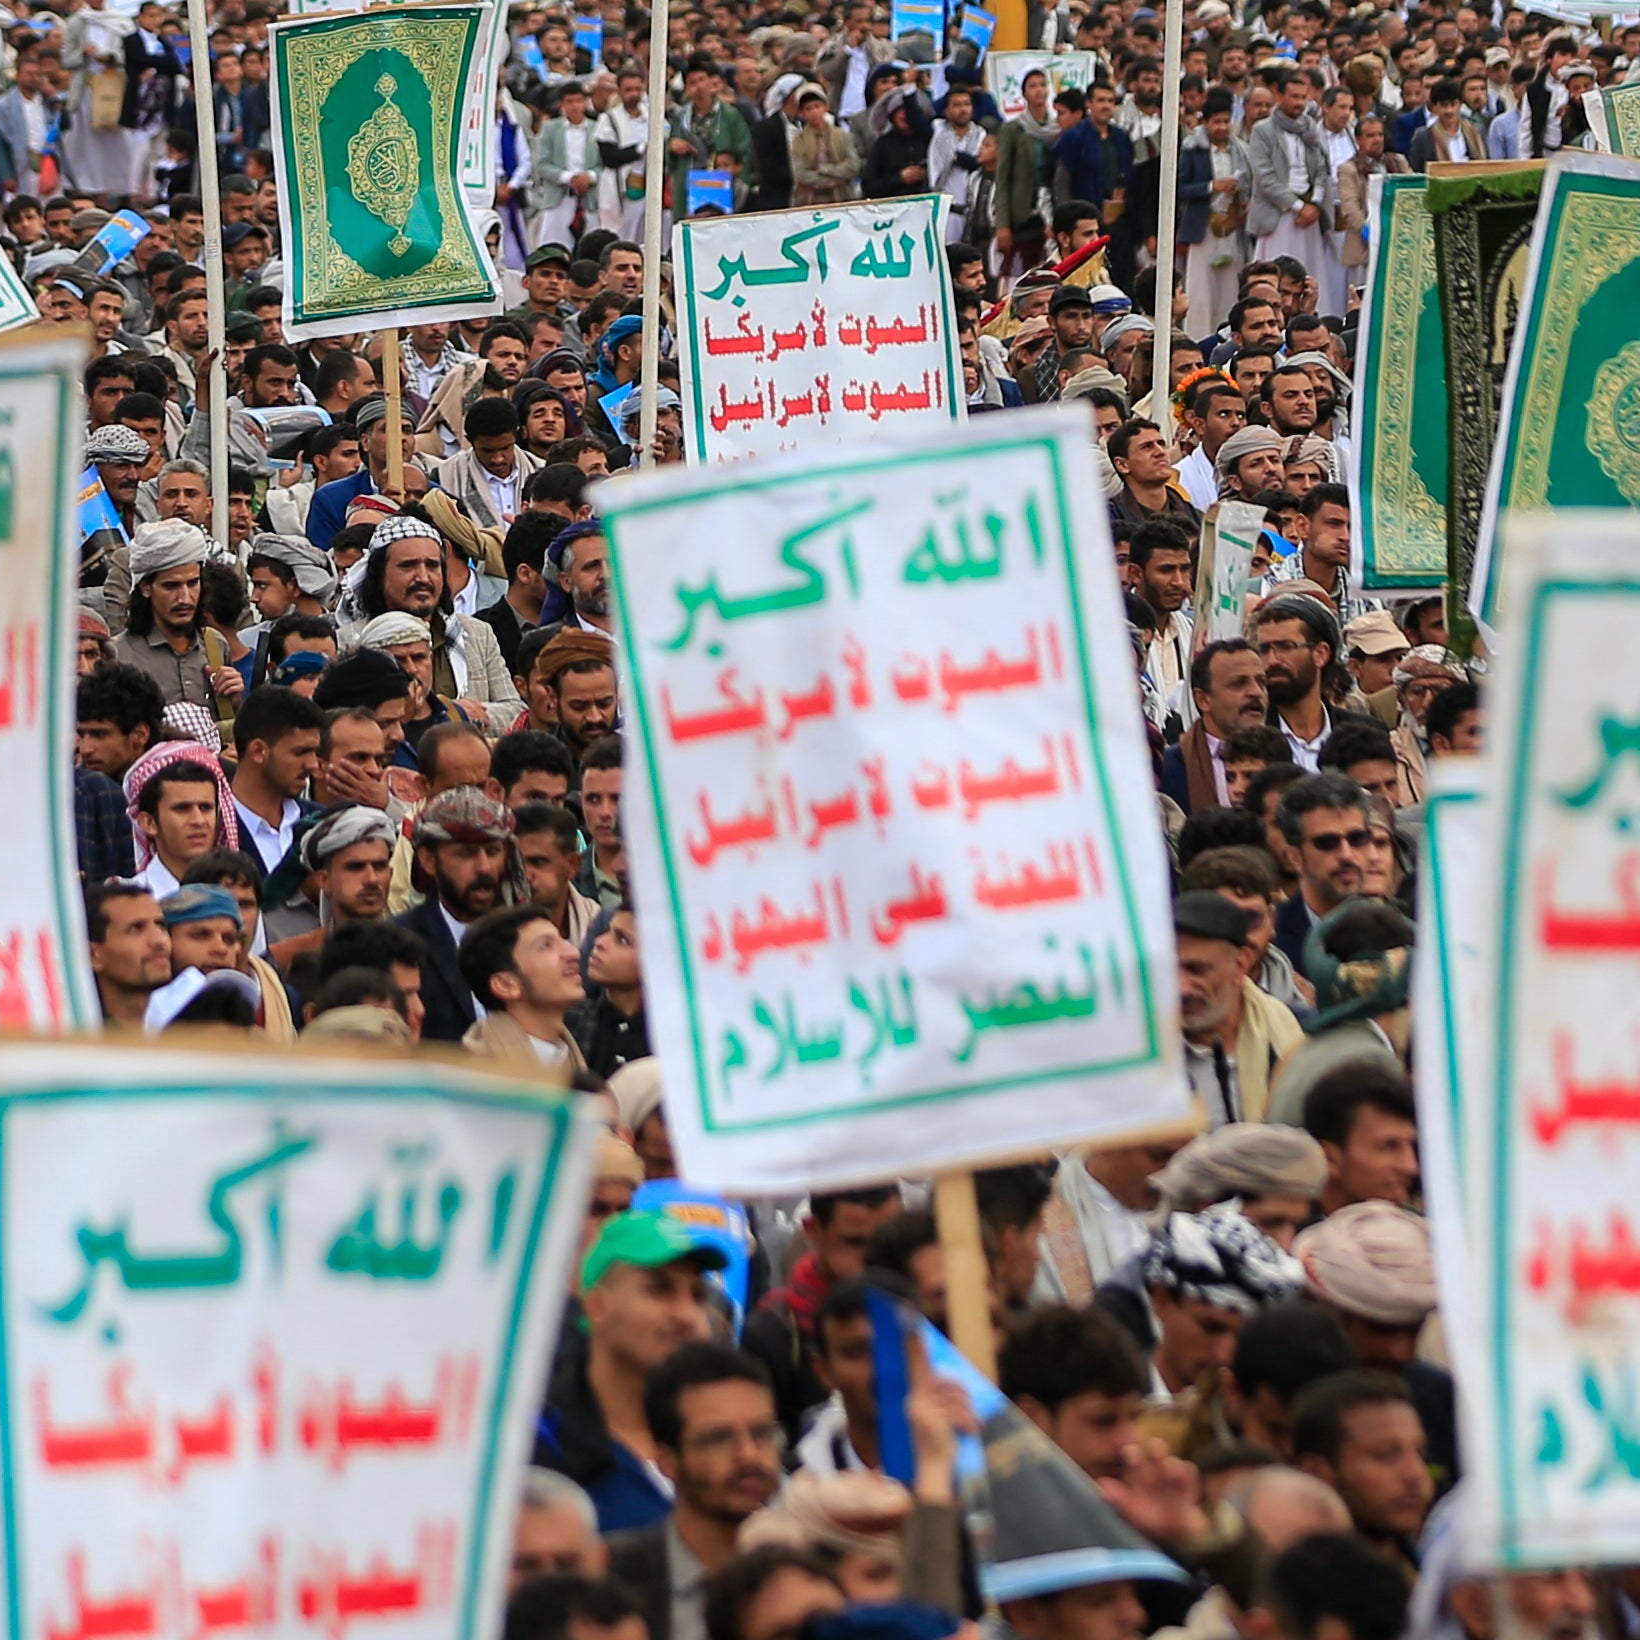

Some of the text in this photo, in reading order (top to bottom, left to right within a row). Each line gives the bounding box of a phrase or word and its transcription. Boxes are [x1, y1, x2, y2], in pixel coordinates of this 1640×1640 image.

[700, 211, 935, 308] الله أكبر
[705, 297, 938, 363] الموت لأمريكا
[710, 367, 943, 432] الموت لإسرائيل
[654, 484, 1048, 658] الله أكبر
[660, 622, 1066, 748] الموت لأمريكا
[686, 736, 1082, 869] الموت لإسرائيل
[701, 836, 1103, 975] اللعنة على اليهود
[719, 931, 1127, 1098] النصر للإسلام
[33, 1116, 518, 1348] الله أكبر
[33, 1337, 482, 1491] الموت لأمريكا
[297, 1518, 457, 1640] الموت
